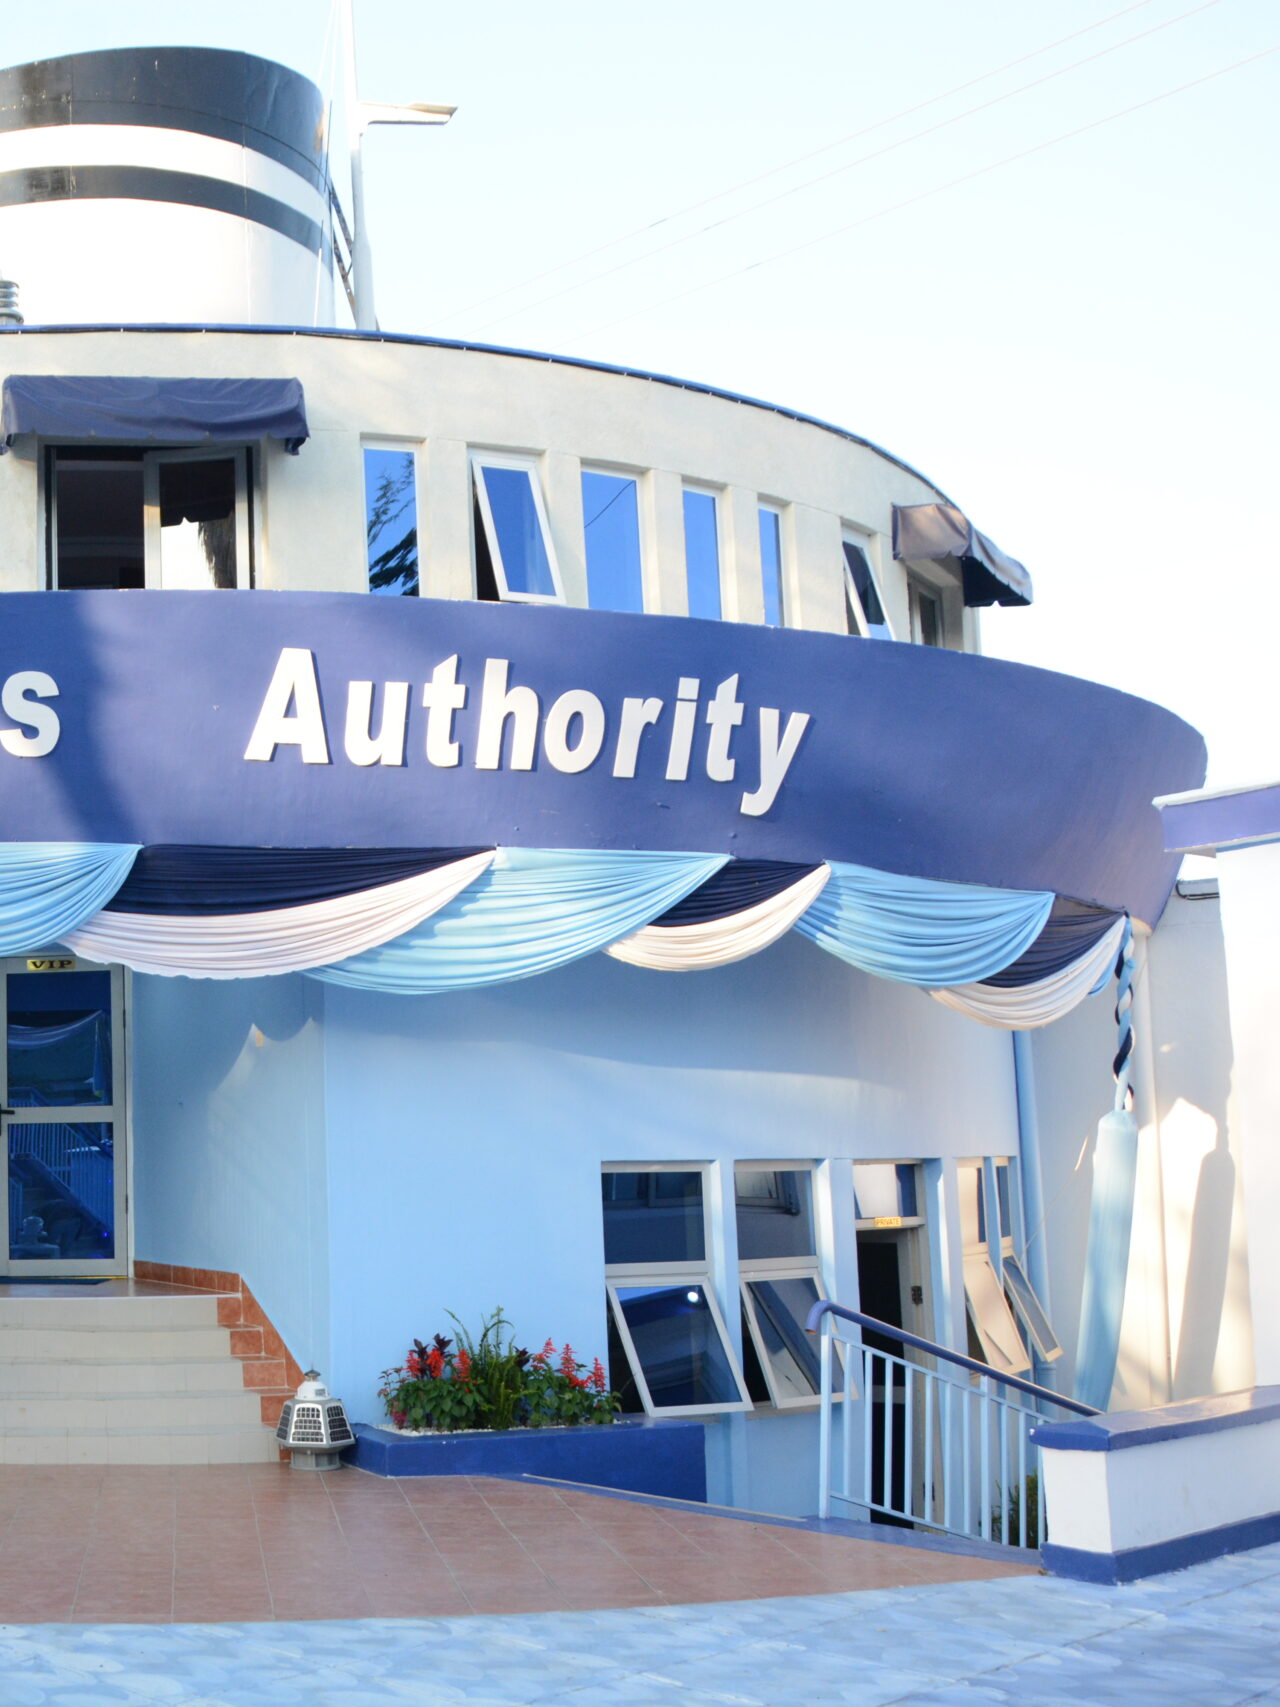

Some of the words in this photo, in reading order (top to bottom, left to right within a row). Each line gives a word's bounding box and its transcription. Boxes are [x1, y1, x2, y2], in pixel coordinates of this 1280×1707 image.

[242, 647, 812, 816] Authority
[31, 960, 73, 969] VIP
[876, 1218, 900, 1226] PRIVATE
